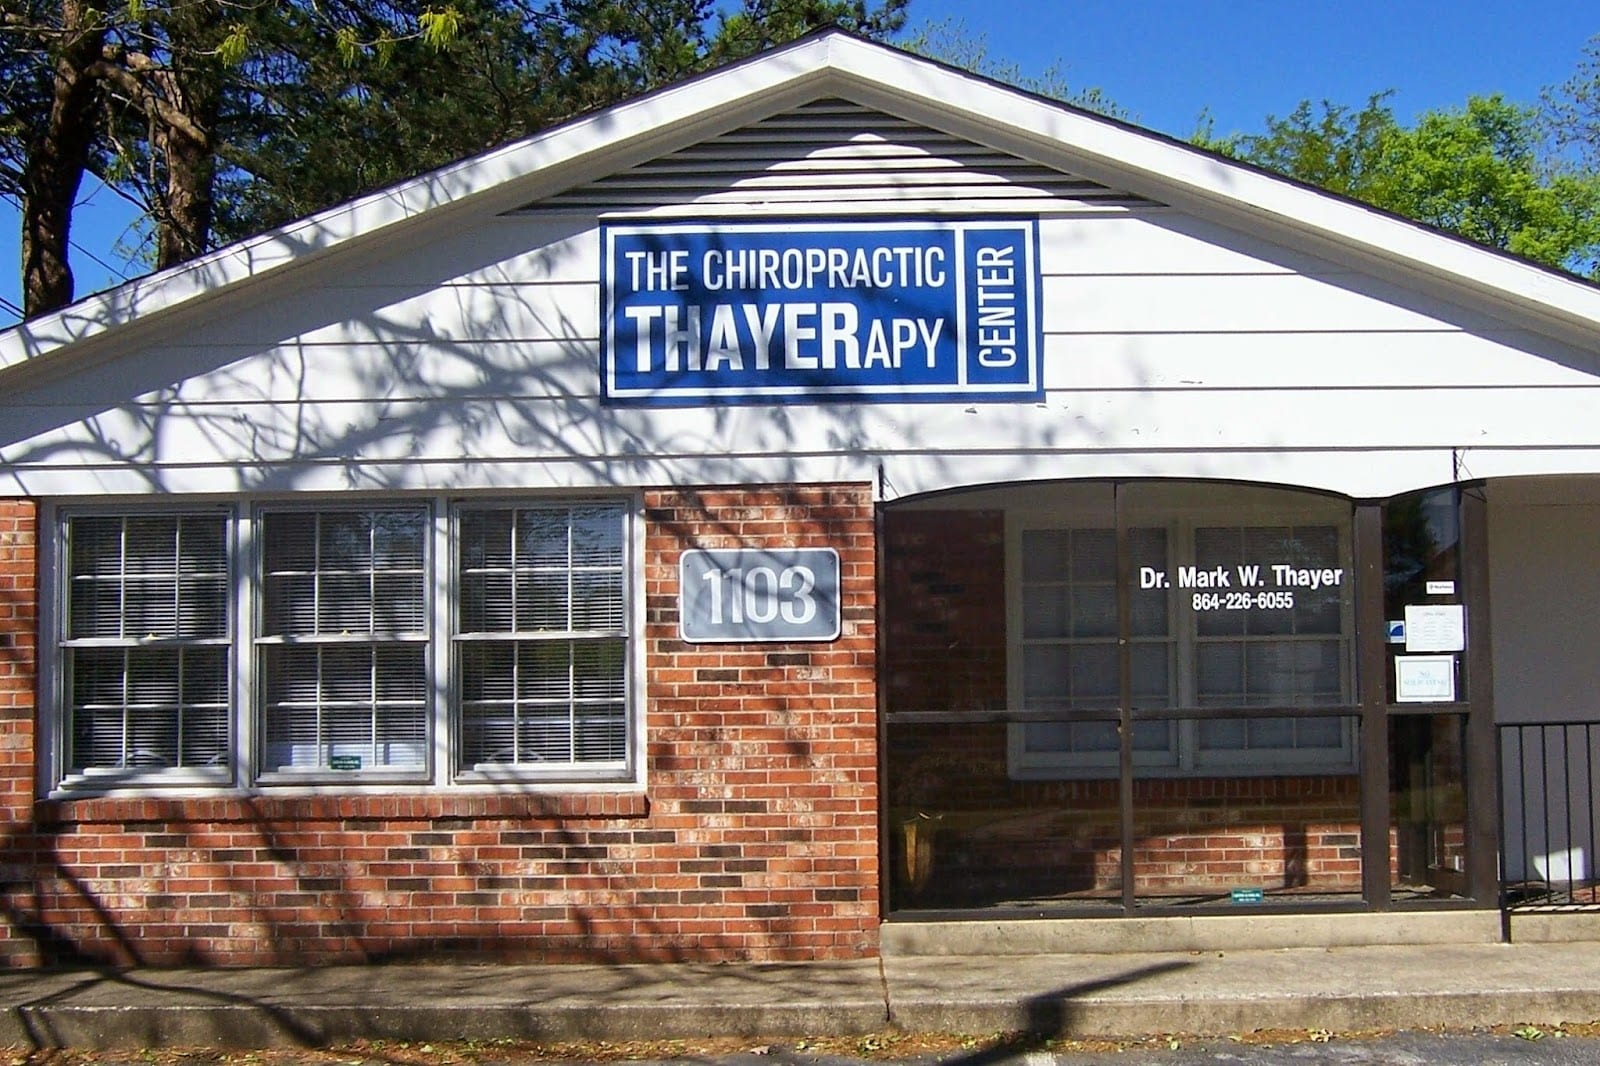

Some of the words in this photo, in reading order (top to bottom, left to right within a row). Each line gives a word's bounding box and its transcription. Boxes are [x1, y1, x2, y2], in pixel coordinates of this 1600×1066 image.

[625, 250, 689, 291] THE
[703, 246, 946, 290] CHIROPRACTIC
[978, 245, 1017, 368] CENTER
[625, 302, 945, 372] THAYERAPY
[702, 565, 817, 625] 1103
[1140, 567, 1170, 588] Dr.
[1178, 566, 1230, 588] Mark
[1237, 565, 1265, 587] W.
[1272, 565, 1343, 589] Thayer
[1192, 592, 1294, 611] 864-226-6055
